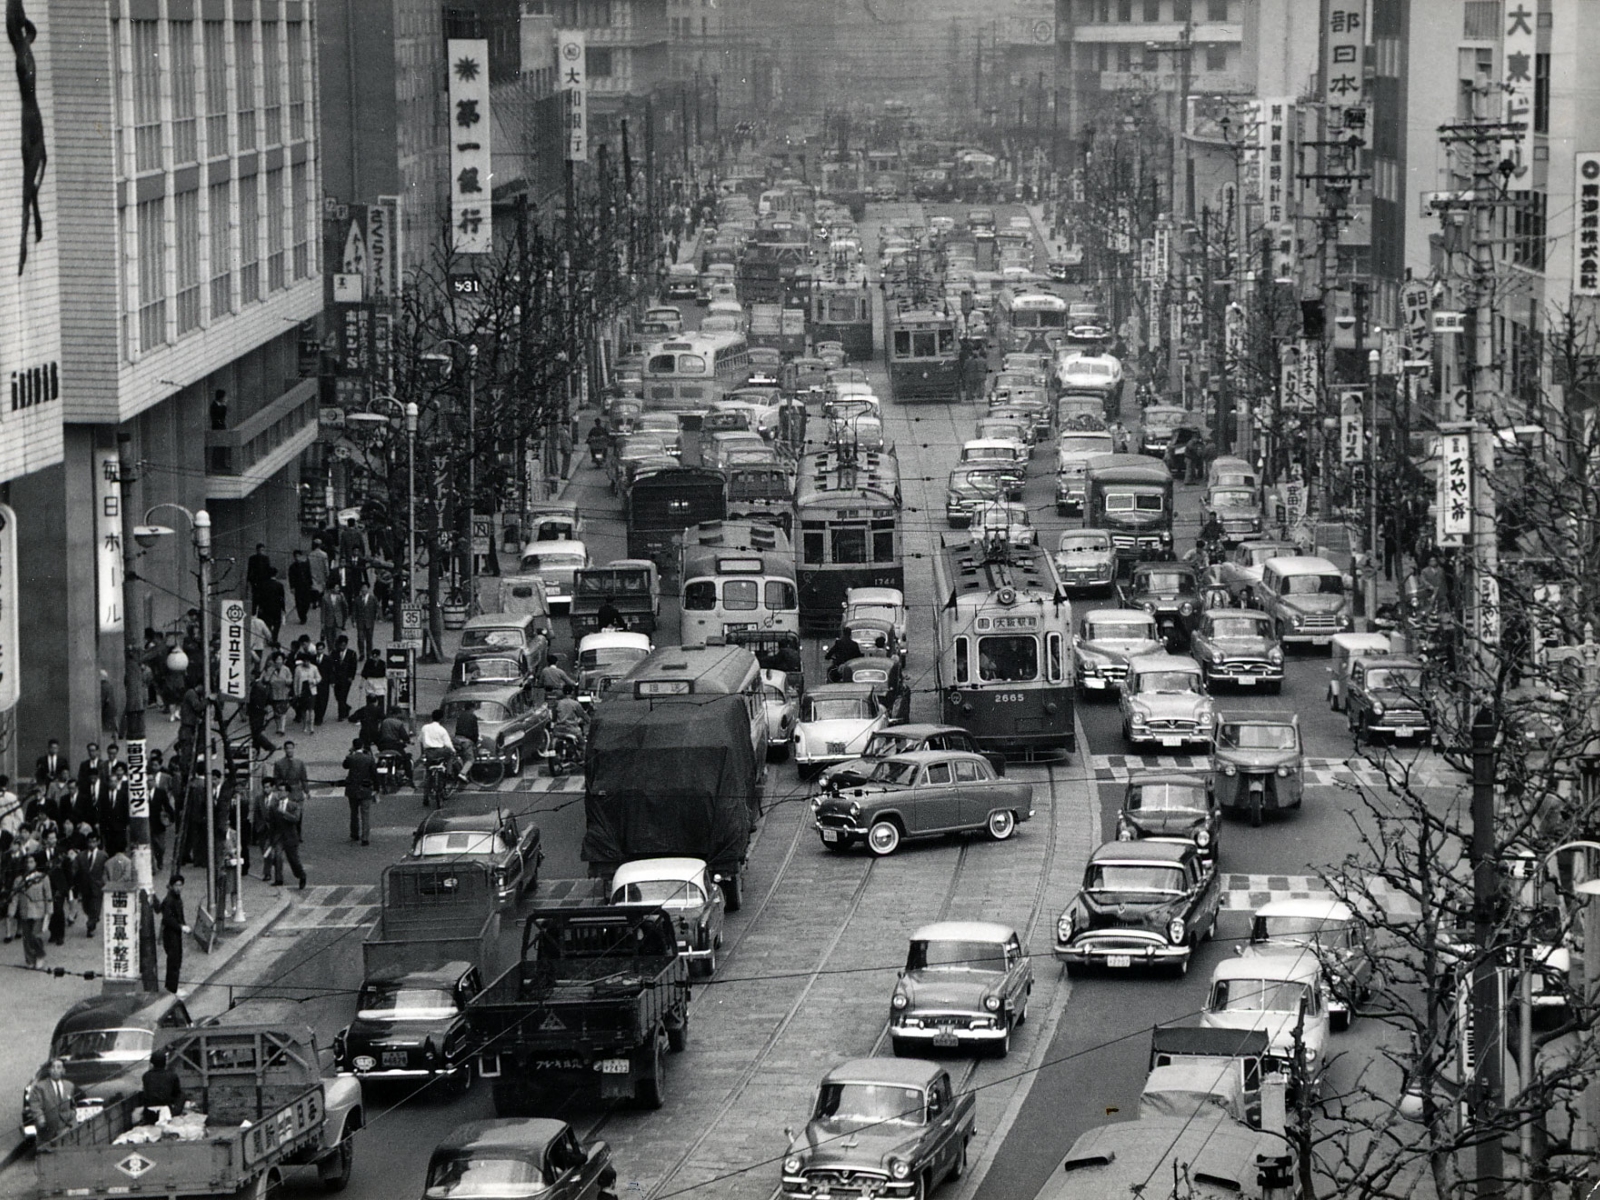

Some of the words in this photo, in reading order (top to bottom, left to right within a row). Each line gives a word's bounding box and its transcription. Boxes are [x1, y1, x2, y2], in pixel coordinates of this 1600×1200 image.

[456, 98, 482, 235] 第一銀行
[1285, 370, 1298, 404] トリス
[1345, 421, 1359, 459] トリス
[103, 460, 121, 623] 毎日ホール
[874, 578, 896, 586] 1744
[405, 612, 418, 624] 35
[227, 625, 242, 695] 日立テレビ
[995, 693, 1025, 703] 2665
